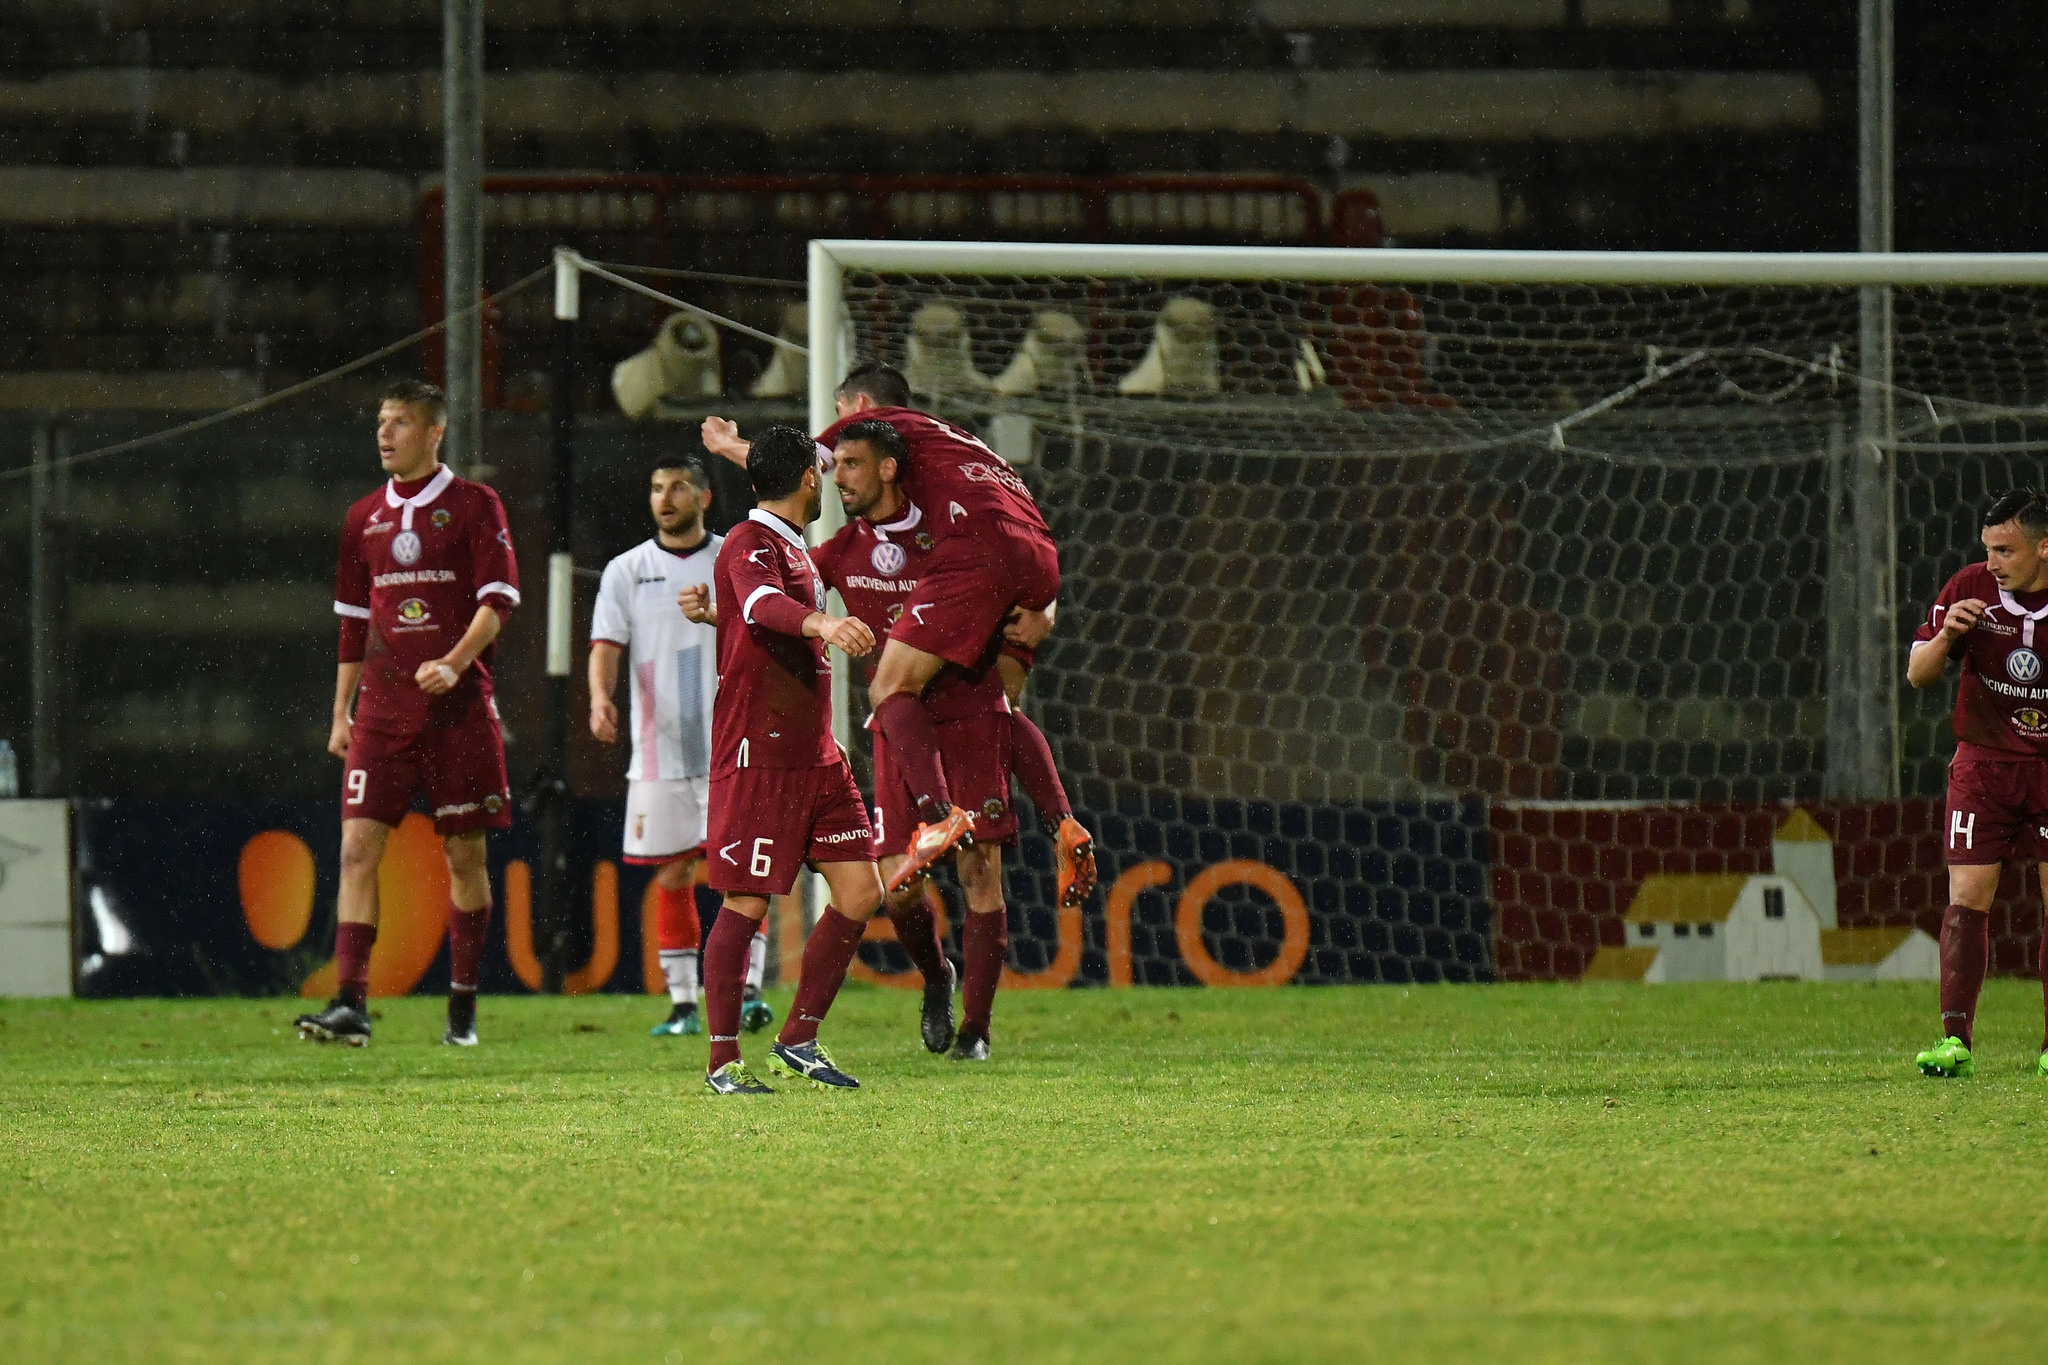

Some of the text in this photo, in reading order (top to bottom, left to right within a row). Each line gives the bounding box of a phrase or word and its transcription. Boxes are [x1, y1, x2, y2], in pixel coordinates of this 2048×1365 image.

[846, 575, 897, 592] BENCIVENNI
[1979, 672, 2028, 699] NCIVENNI
[346, 769, 368, 805] 9
[1950, 810, 1975, 850] 14
[750, 837, 774, 878] 6
